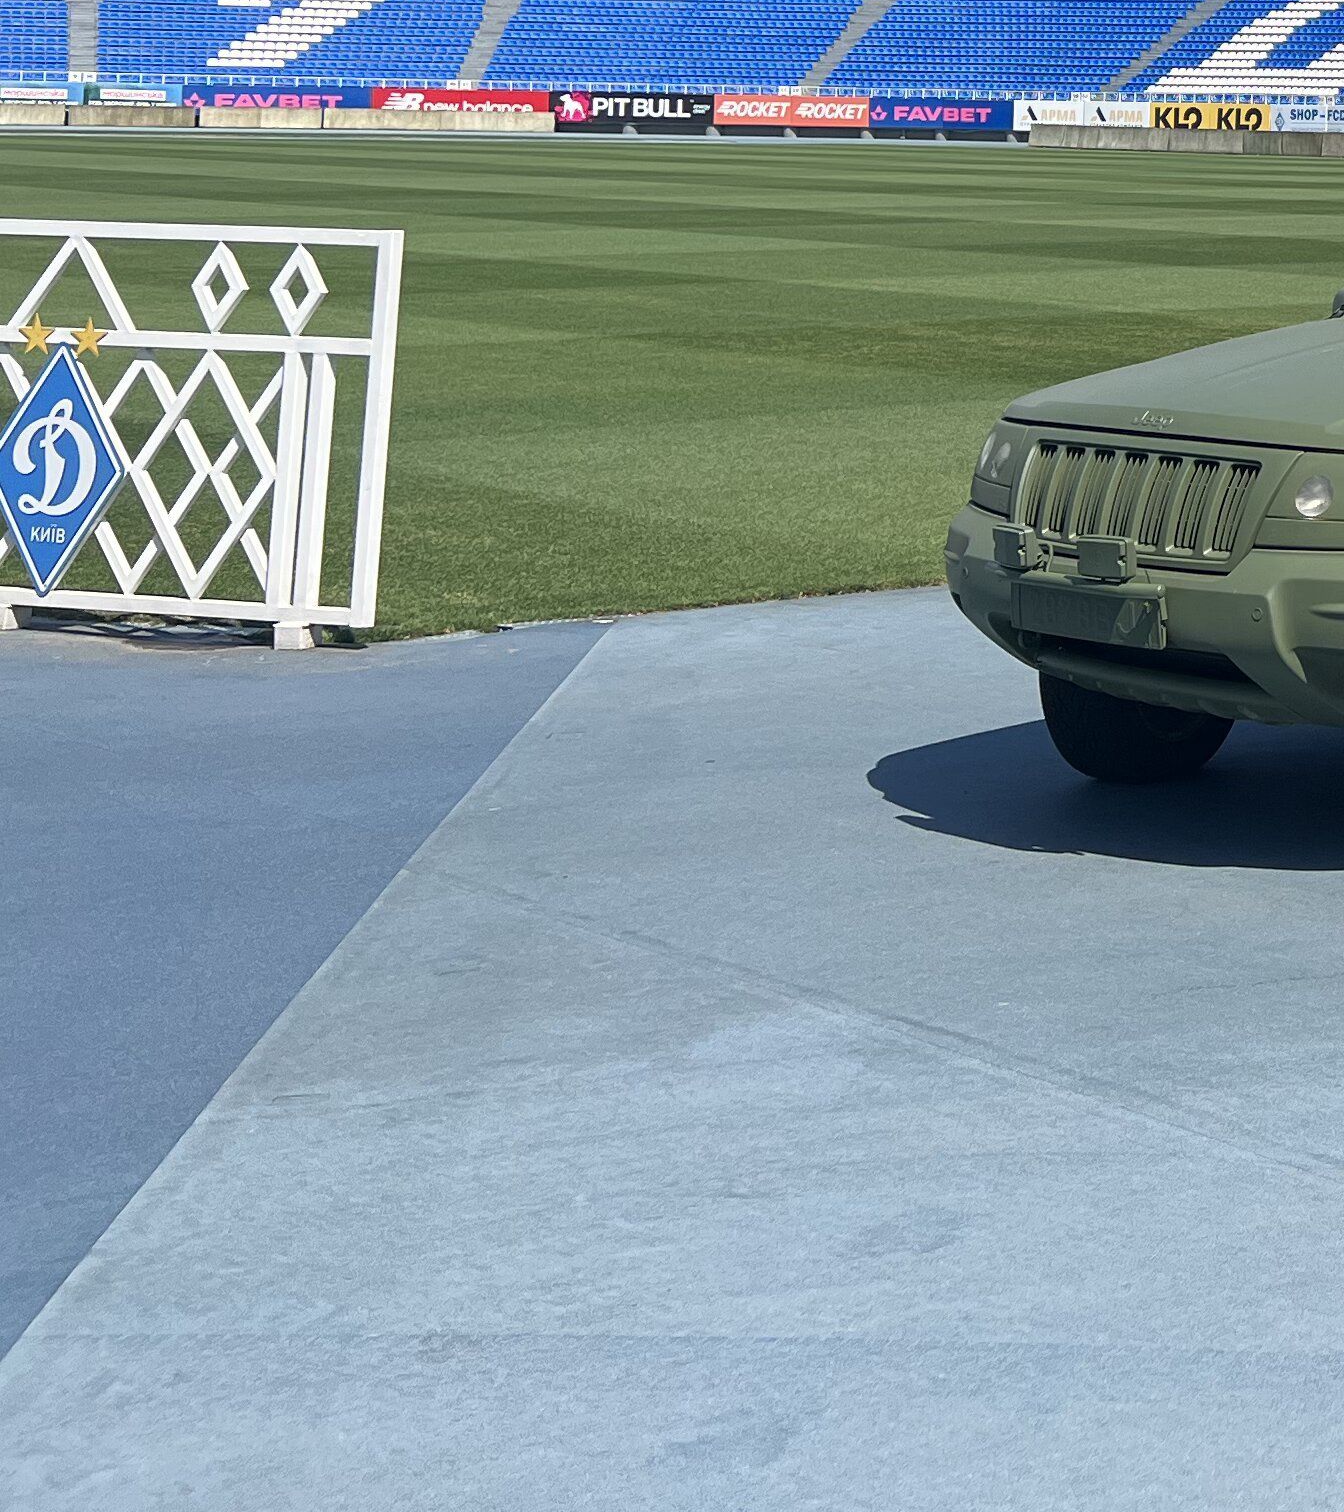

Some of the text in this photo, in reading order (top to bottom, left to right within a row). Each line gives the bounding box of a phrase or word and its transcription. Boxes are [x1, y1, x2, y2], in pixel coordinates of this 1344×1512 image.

[215, 93, 342, 109] FAVBET
[593, 97, 630, 117] PIT
[631, 97, 691, 119] BULL
[717, 102, 790, 118] ROCKET
[795, 102, 867, 120] ROCKET
[894, 106, 991, 123] FAVBET
[1154, 107, 1203, 129] KLO
[1217, 107, 1263, 131] KLO
[1131, 409, 1175, 432] Jeep
[30, 523, 67, 545] КИЇВ
